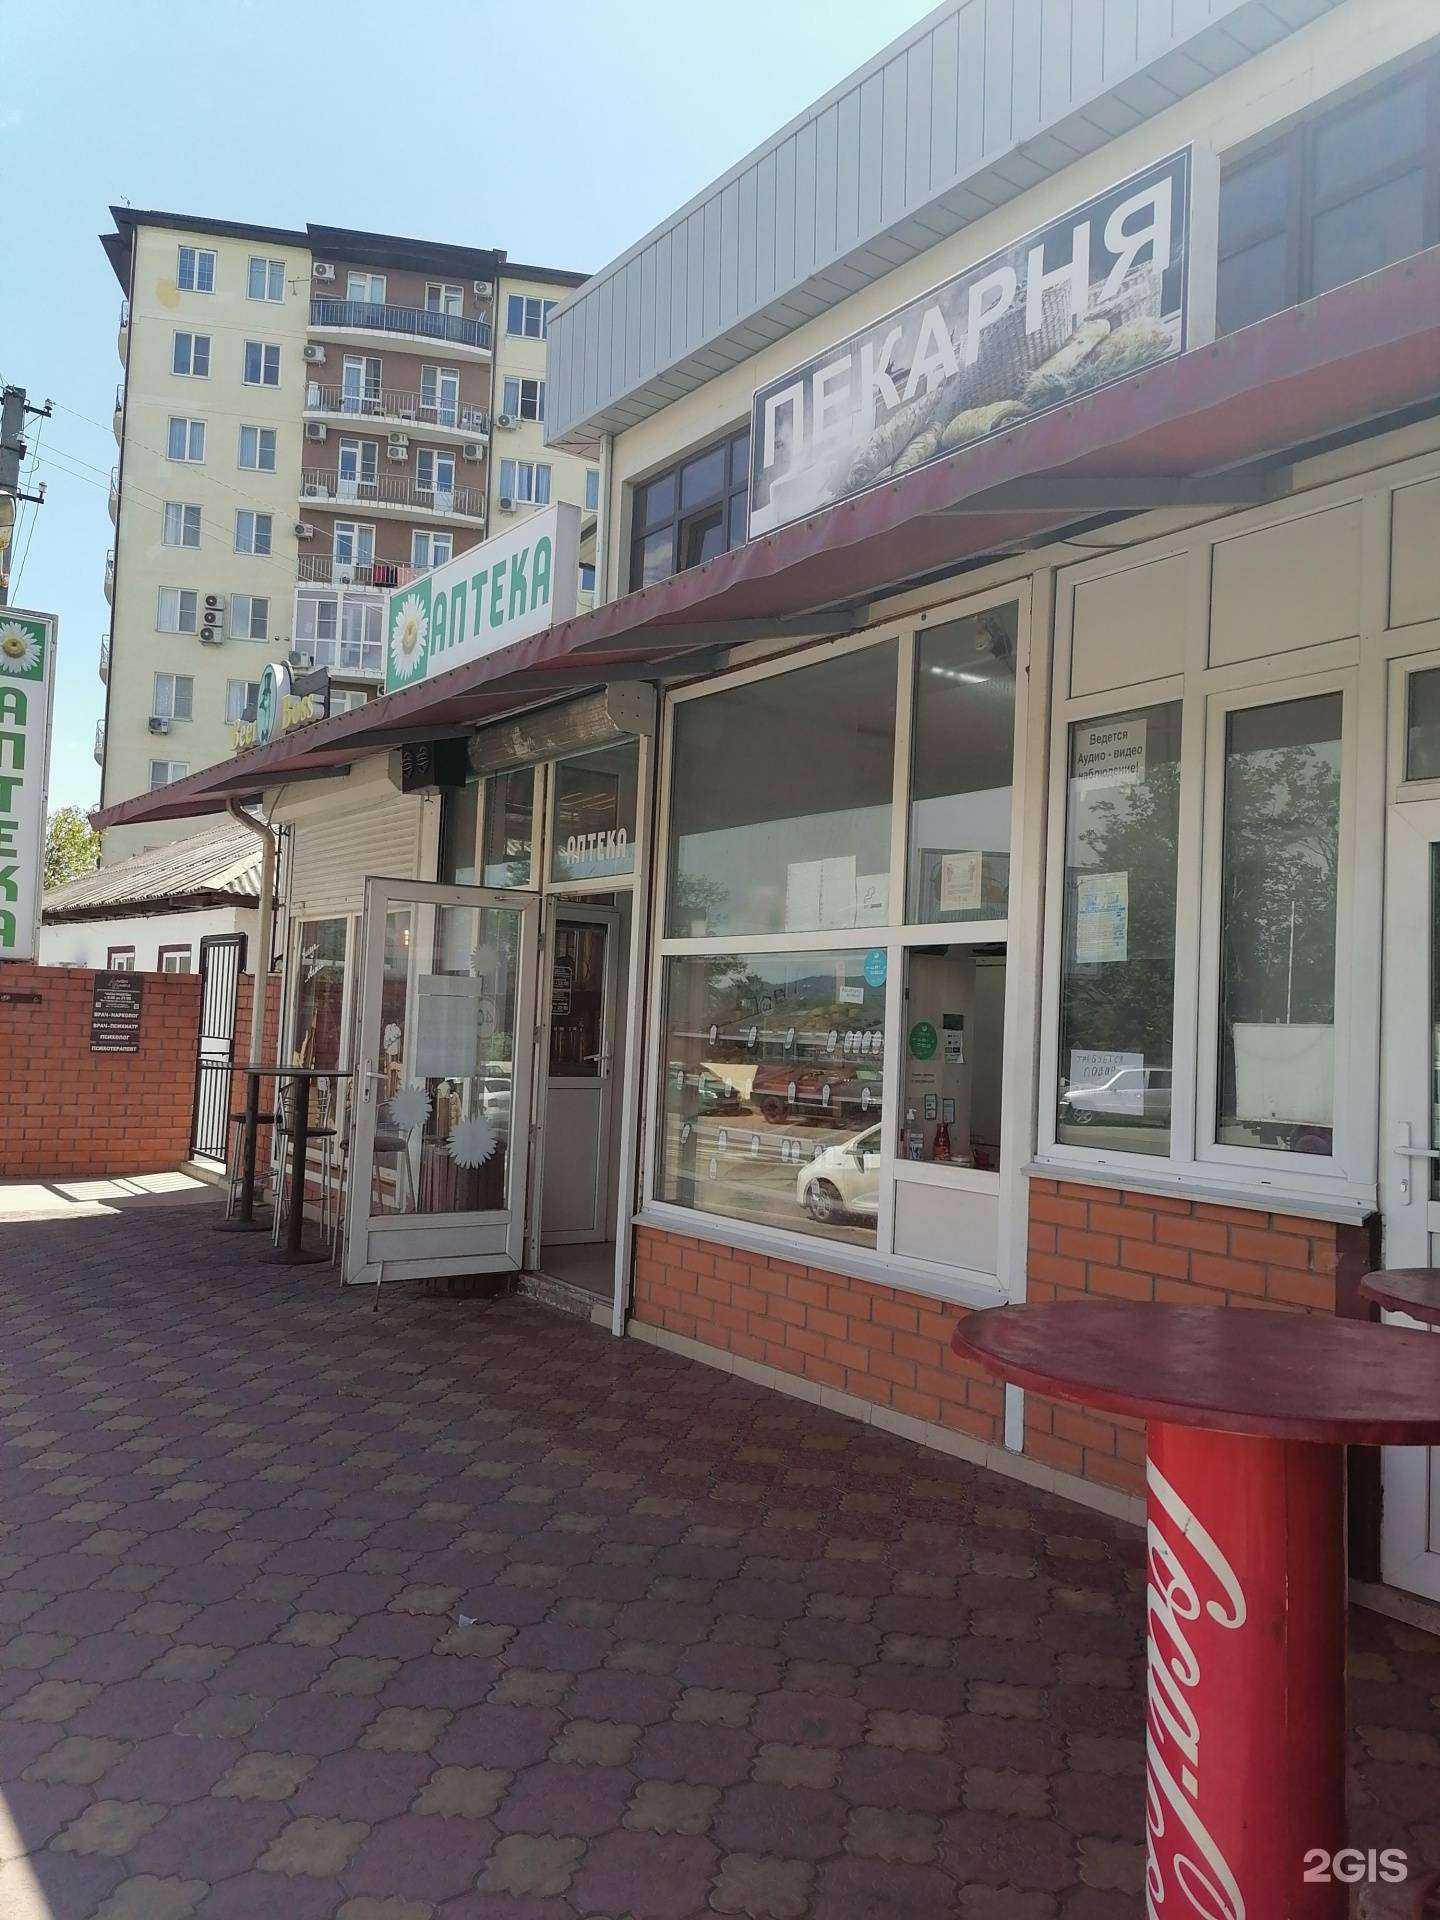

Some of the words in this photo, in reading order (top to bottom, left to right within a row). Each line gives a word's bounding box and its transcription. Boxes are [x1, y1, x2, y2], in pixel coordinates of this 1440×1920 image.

[764, 176, 1172, 469] ПЕКАРНЯ
[430, 536, 552, 656] АПТЕКА
[1078, 752, 1106, 766] Аудио
[1113, 746, 1143, 759] видео
[1089, 730, 1128, 746] Ведется
[567, 828, 627, 864] АПТЕКА
